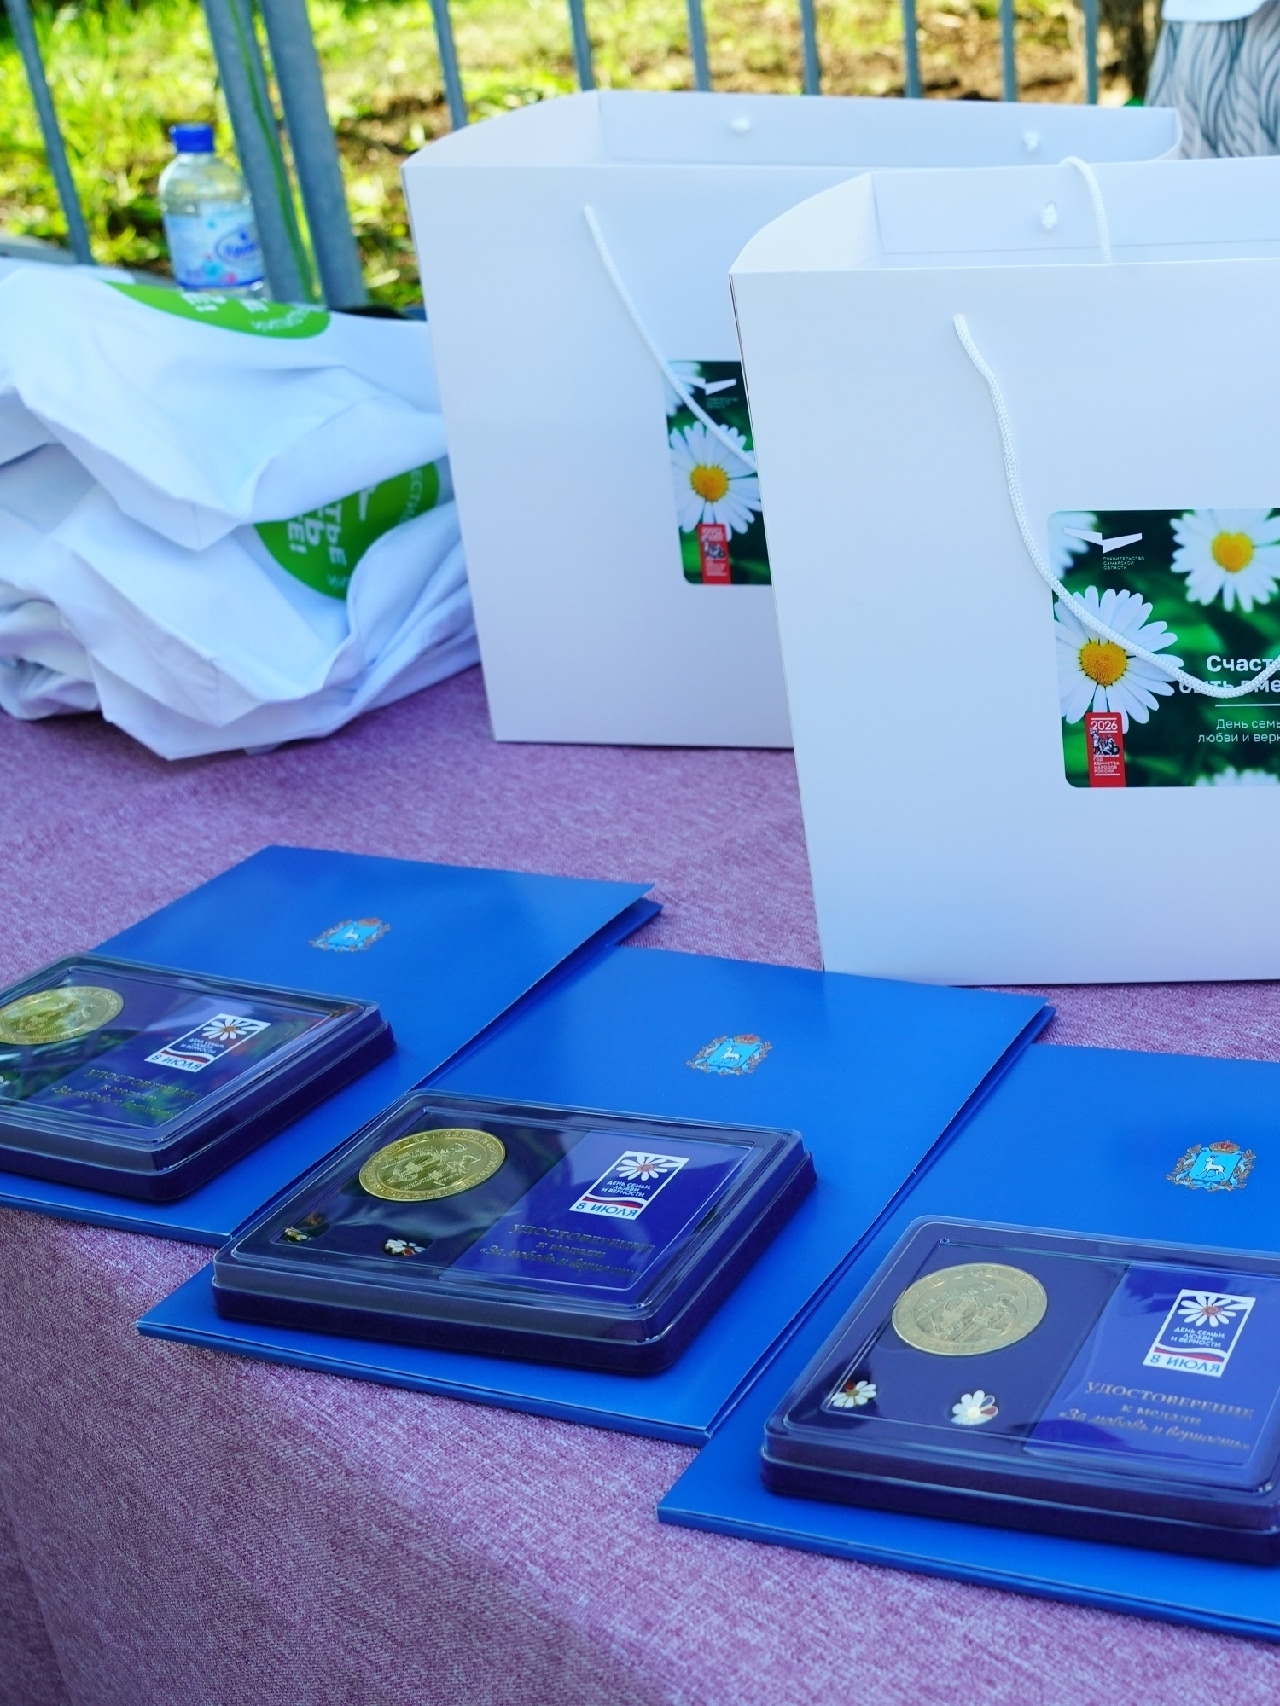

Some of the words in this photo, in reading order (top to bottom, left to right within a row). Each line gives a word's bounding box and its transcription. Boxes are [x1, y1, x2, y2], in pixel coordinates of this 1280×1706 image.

[1216, 718, 1249, 731] День
[1197, 732, 1239, 743] любви
[1242, 734, 1250, 742] и
[575, 1202, 587, 1210] 8
[590, 1203, 638, 1217] ИЮЛЯ
[1149, 1354, 1161, 1364] 8
[1166, 1356, 1222, 1373] ИЮЛЯ
